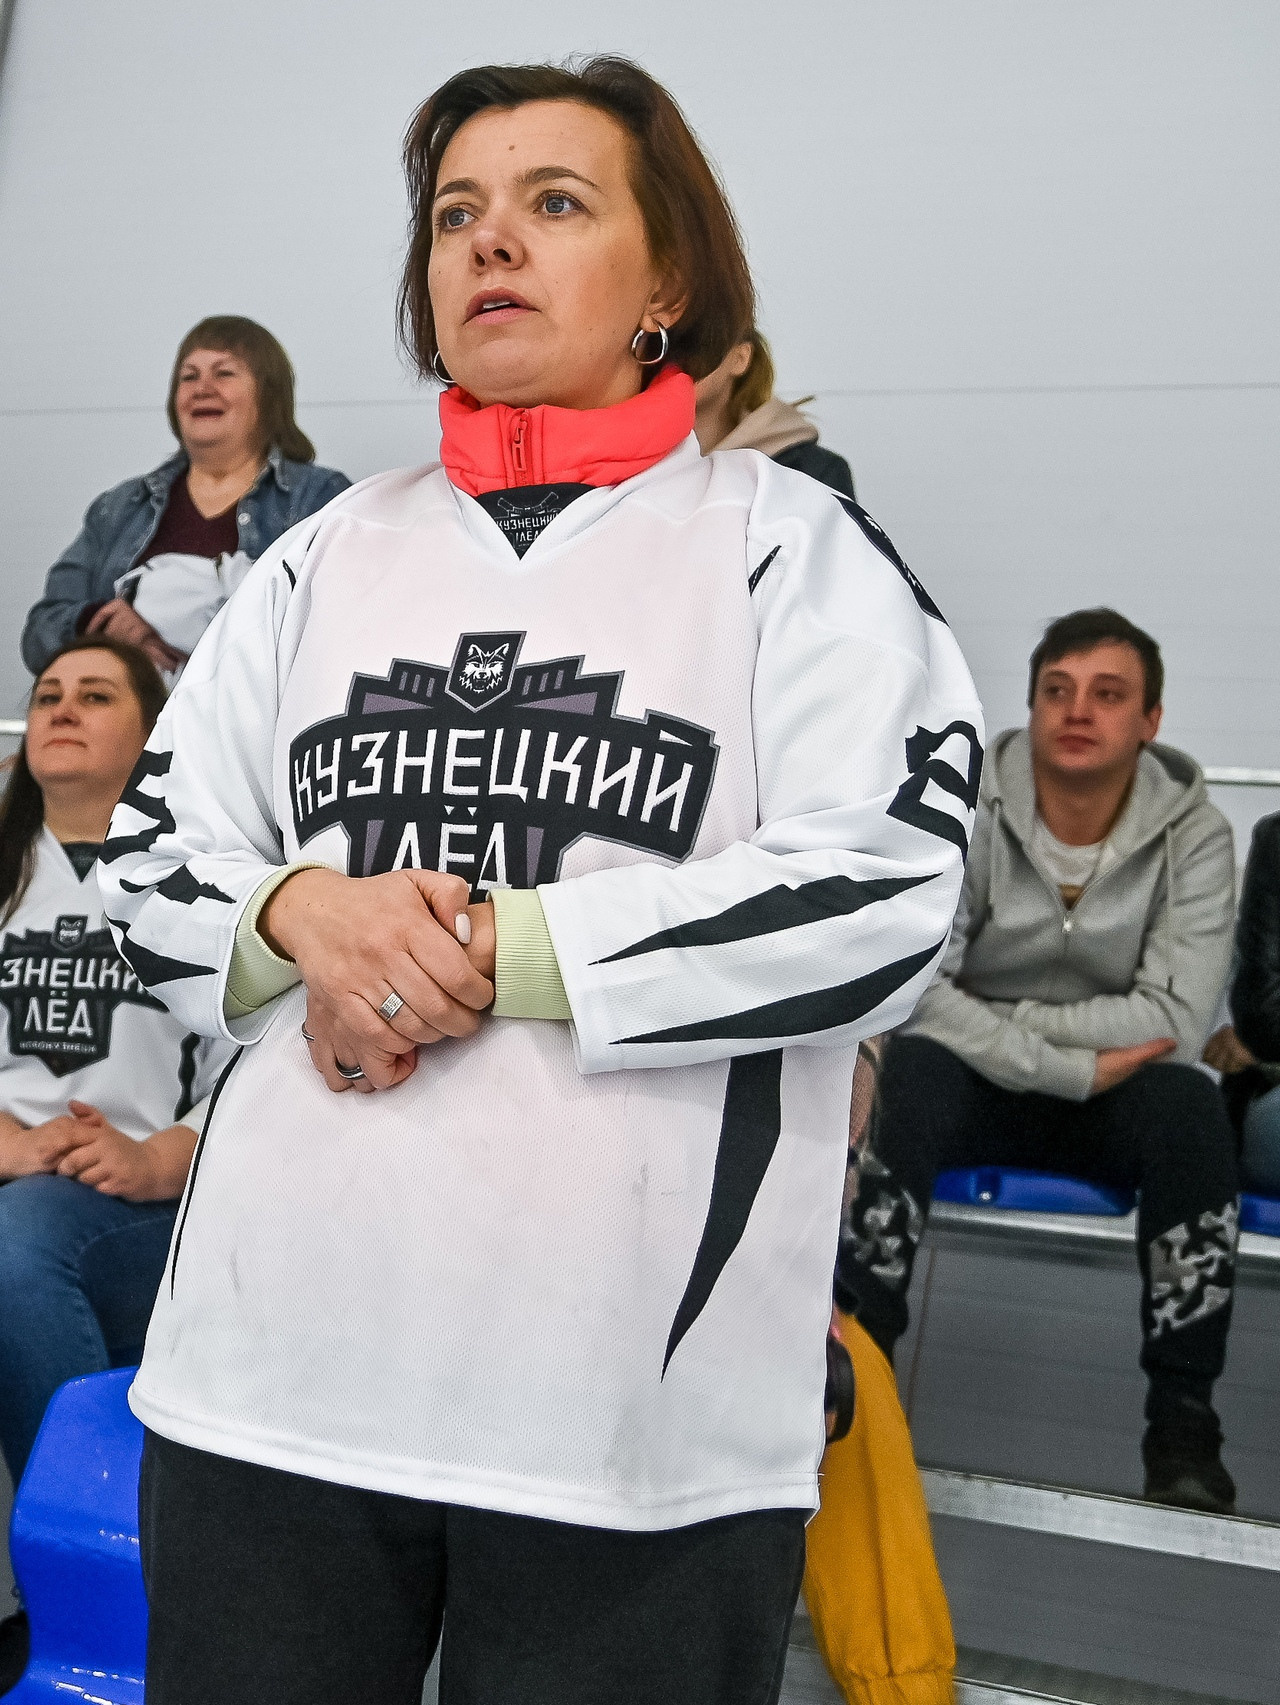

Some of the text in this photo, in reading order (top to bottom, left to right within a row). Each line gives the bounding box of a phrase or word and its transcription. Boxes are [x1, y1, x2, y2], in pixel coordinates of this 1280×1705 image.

[294, 728, 693, 833] КУЗНЕЦКИЙ
[391, 805, 513, 891] ЛЁД
[23, 990, 94, 1038] ЛЁД
